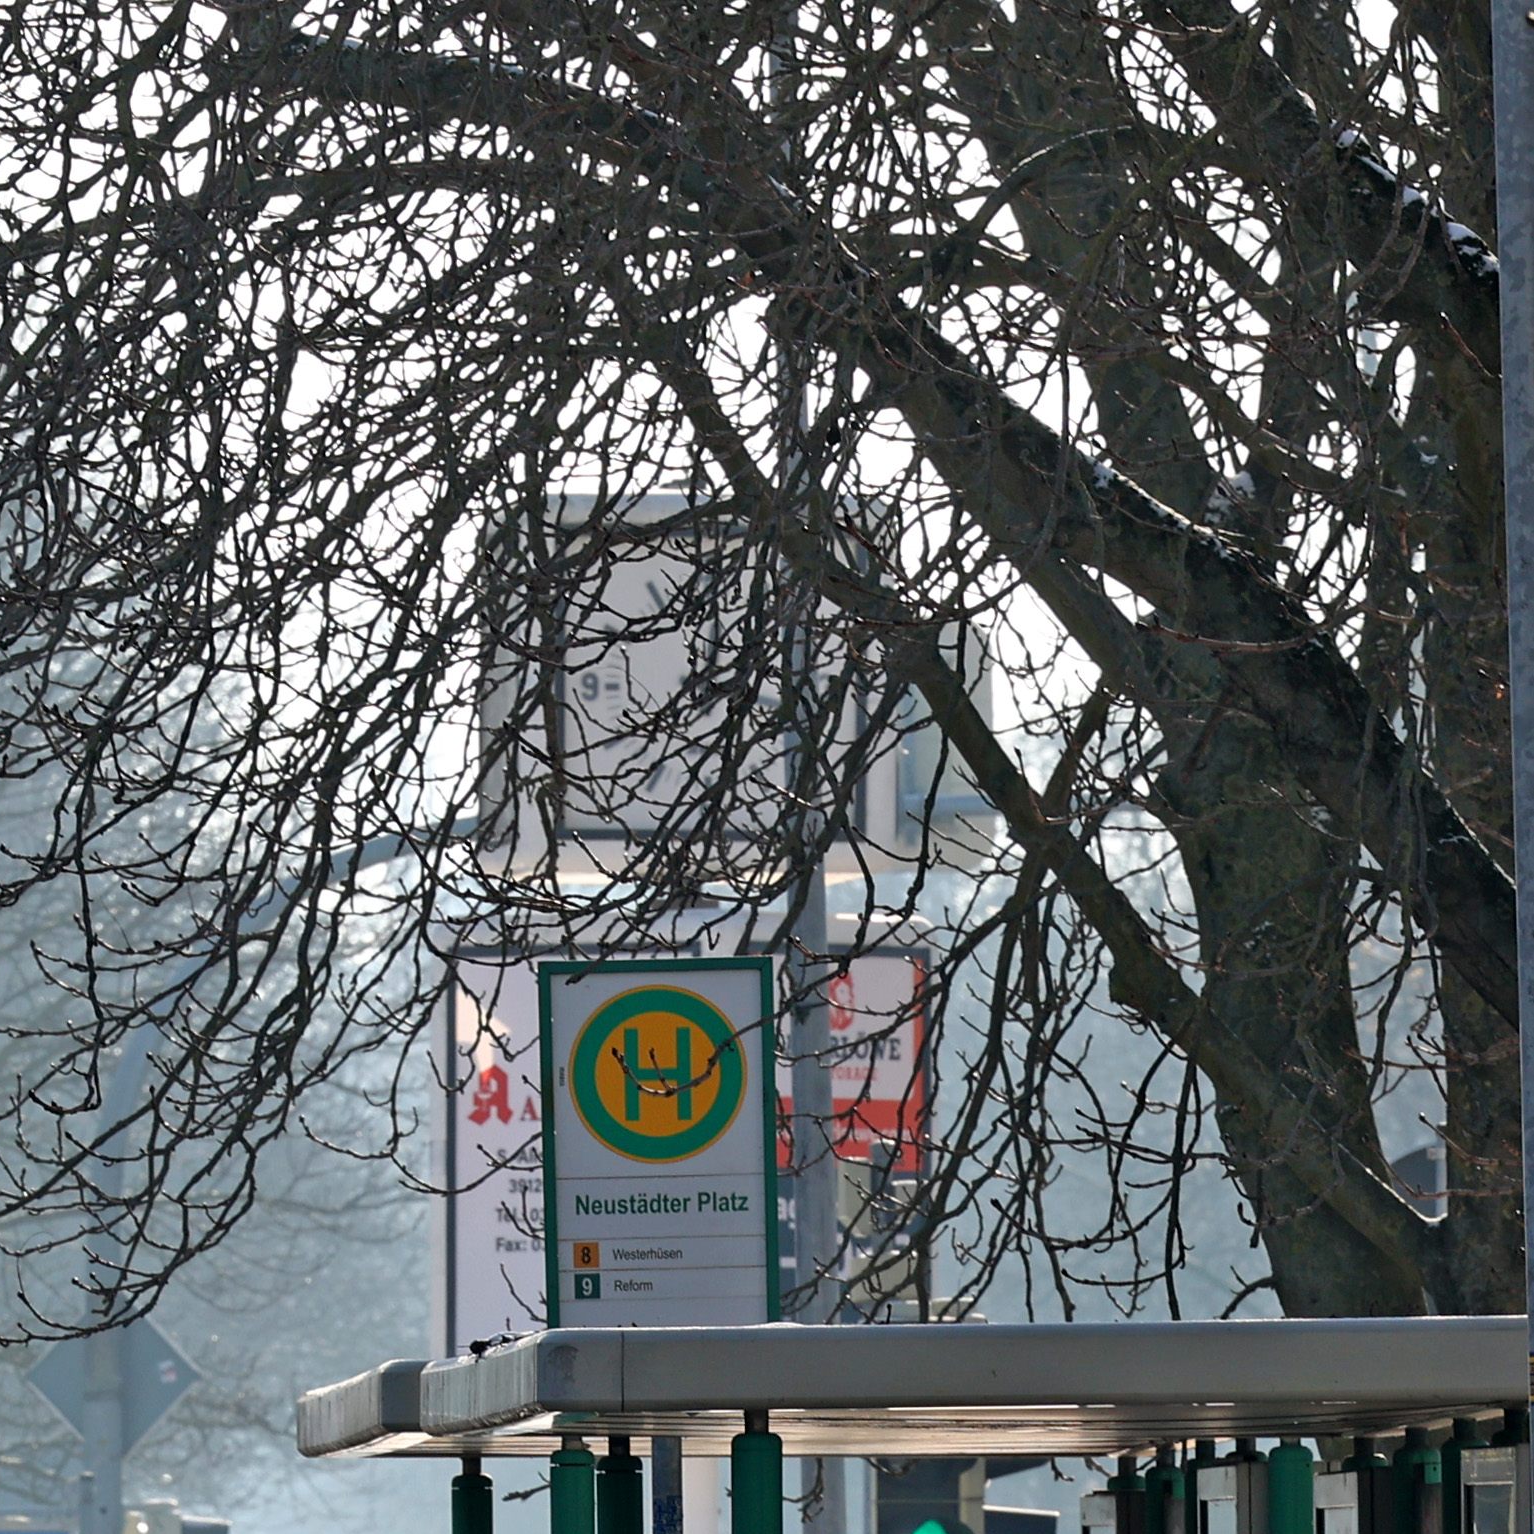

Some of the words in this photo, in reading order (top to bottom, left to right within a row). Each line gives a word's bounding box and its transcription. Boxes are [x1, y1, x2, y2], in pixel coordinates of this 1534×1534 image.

[623, 1026, 693, 1122] H
[574, 1192, 692, 1216] Neustädter
[696, 1190, 750, 1213] Platz
[580, 1246, 592, 1265] 8
[612, 1246, 684, 1261] Westerhüsen
[581, 1277, 593, 1297] 9
[613, 1279, 654, 1293] Reform
